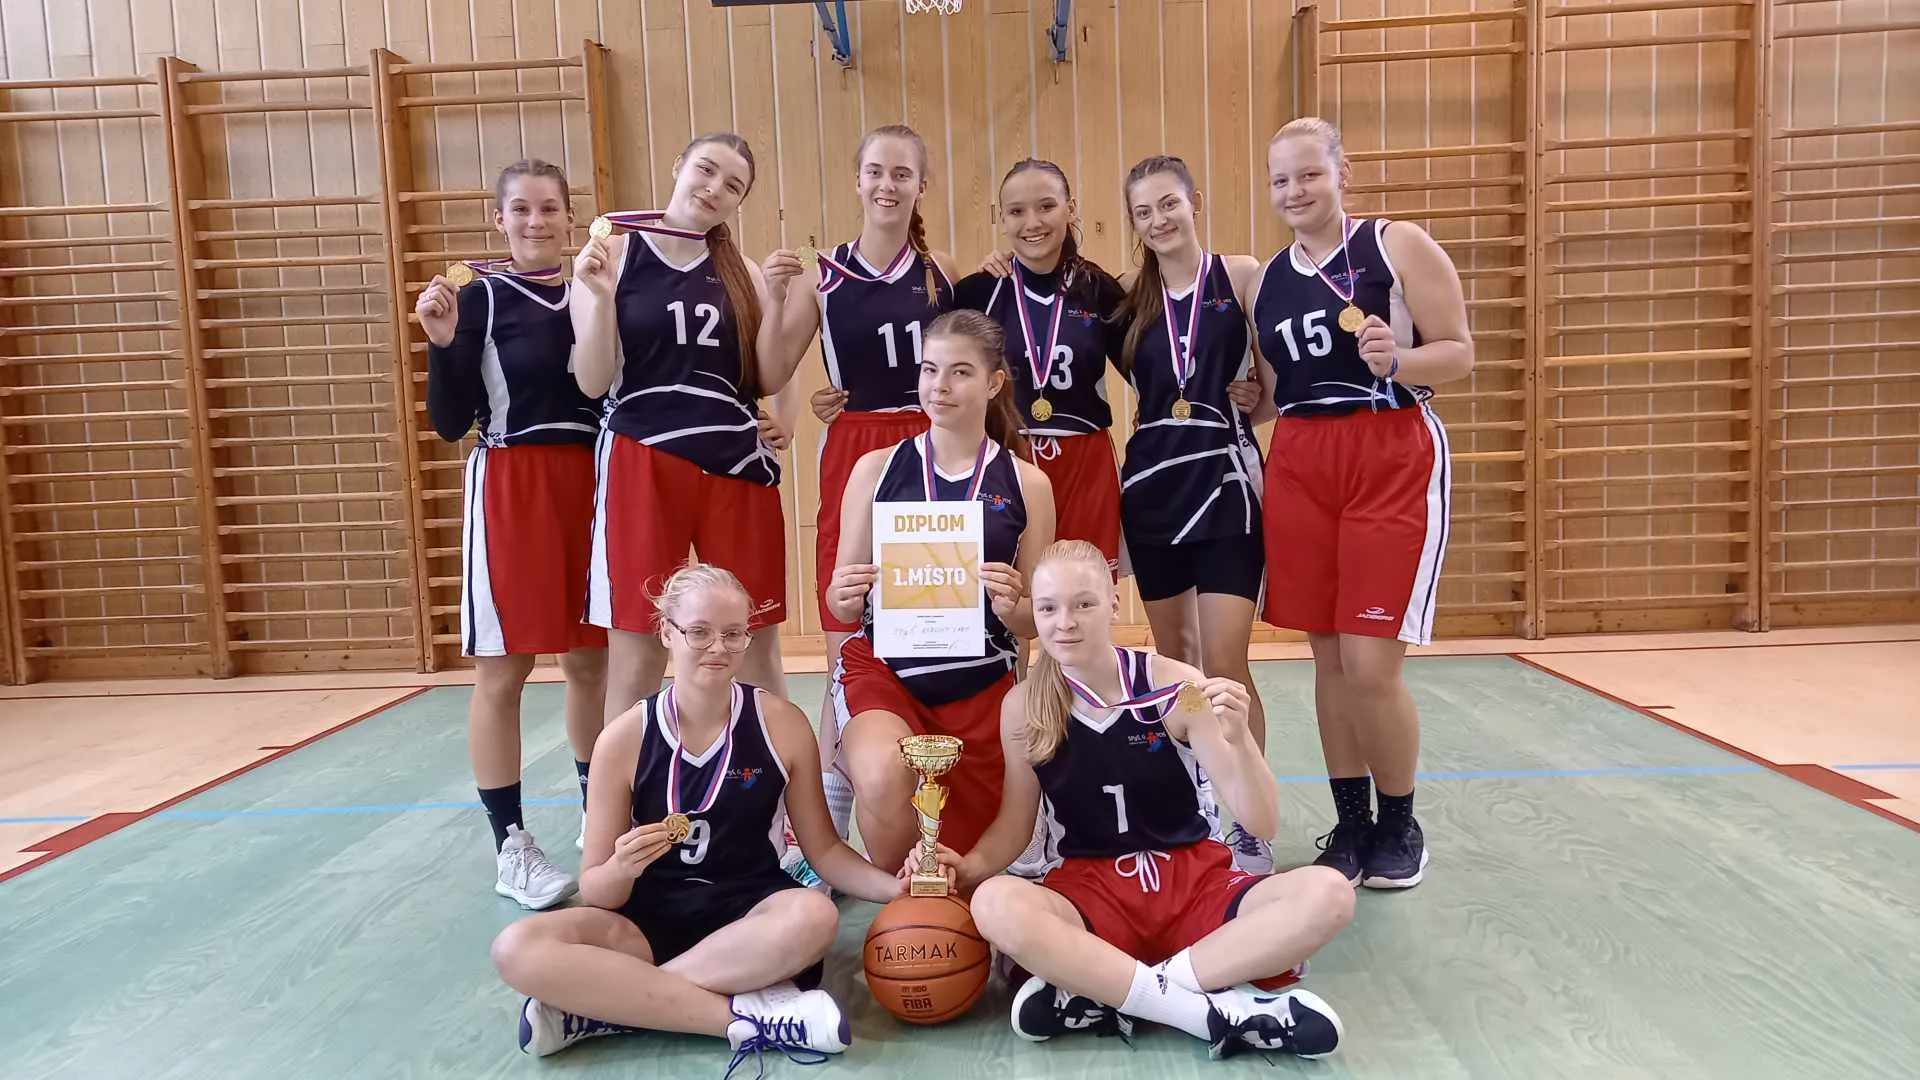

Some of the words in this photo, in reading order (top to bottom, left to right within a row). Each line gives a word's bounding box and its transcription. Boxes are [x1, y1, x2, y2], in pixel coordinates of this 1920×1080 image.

[667, 301, 720, 347] 12
[878, 320, 923, 368] 11
[1274, 309, 1333, 362] 15
[1025, 344, 1074, 391] 3
[894, 514, 965, 532] DIPLOM
[1102, 784, 1129, 834] 1
[680, 819, 711, 865] 9
[875, 943, 958, 962] TARMAK
[902, 998, 933, 1009] FIBA
